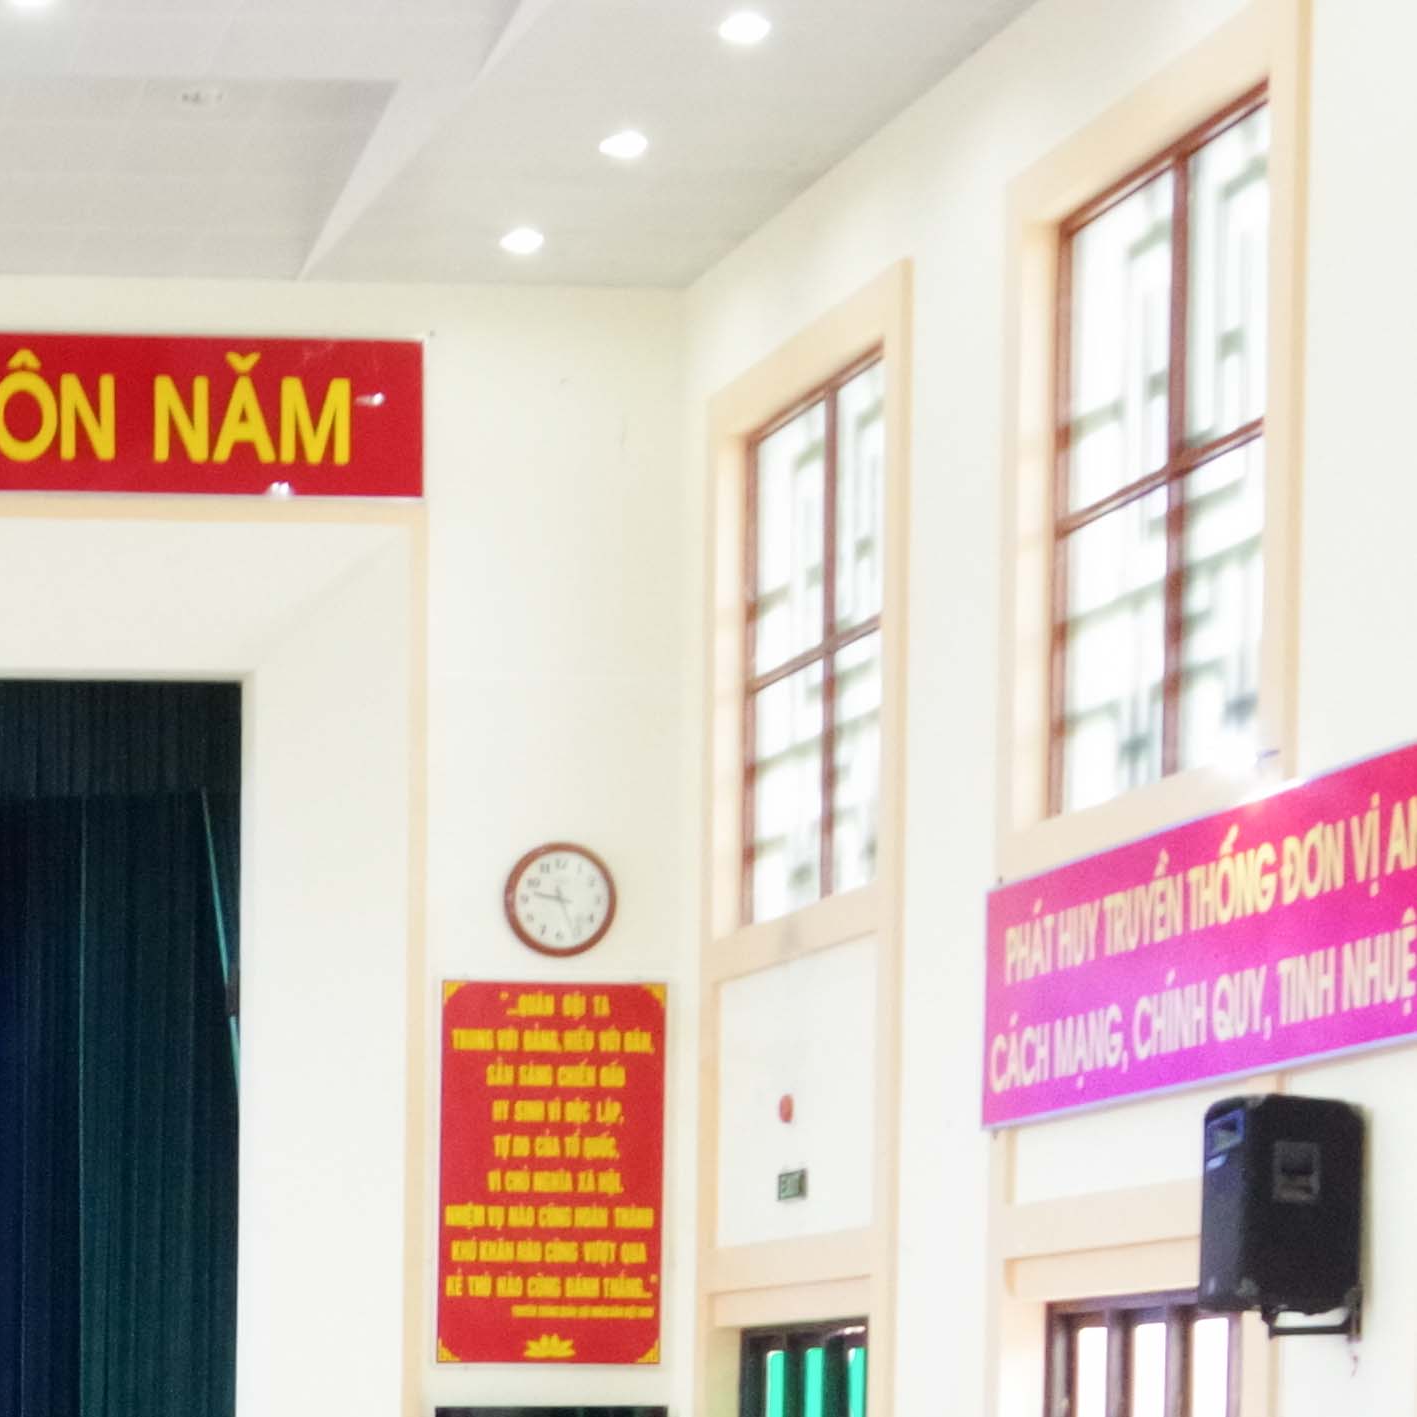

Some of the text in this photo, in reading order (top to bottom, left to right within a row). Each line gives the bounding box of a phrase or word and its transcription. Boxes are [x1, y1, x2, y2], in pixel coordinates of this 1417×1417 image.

[153, 353, 351, 466] NĂM
[1004, 898, 1054, 985] PHÁT
[1056, 899, 1102, 969] HUY
[1102, 848, 1183, 957] TRUYỀN
[1189, 824, 1279, 931] THỐNG
[1280, 819, 1347, 906] ĐƠN
[1350, 792, 1381, 898] VỊ
[988, 905, 1417, 1093] CÁCH MẠNG, CHÍNH QUY, TINH NHUỆ
